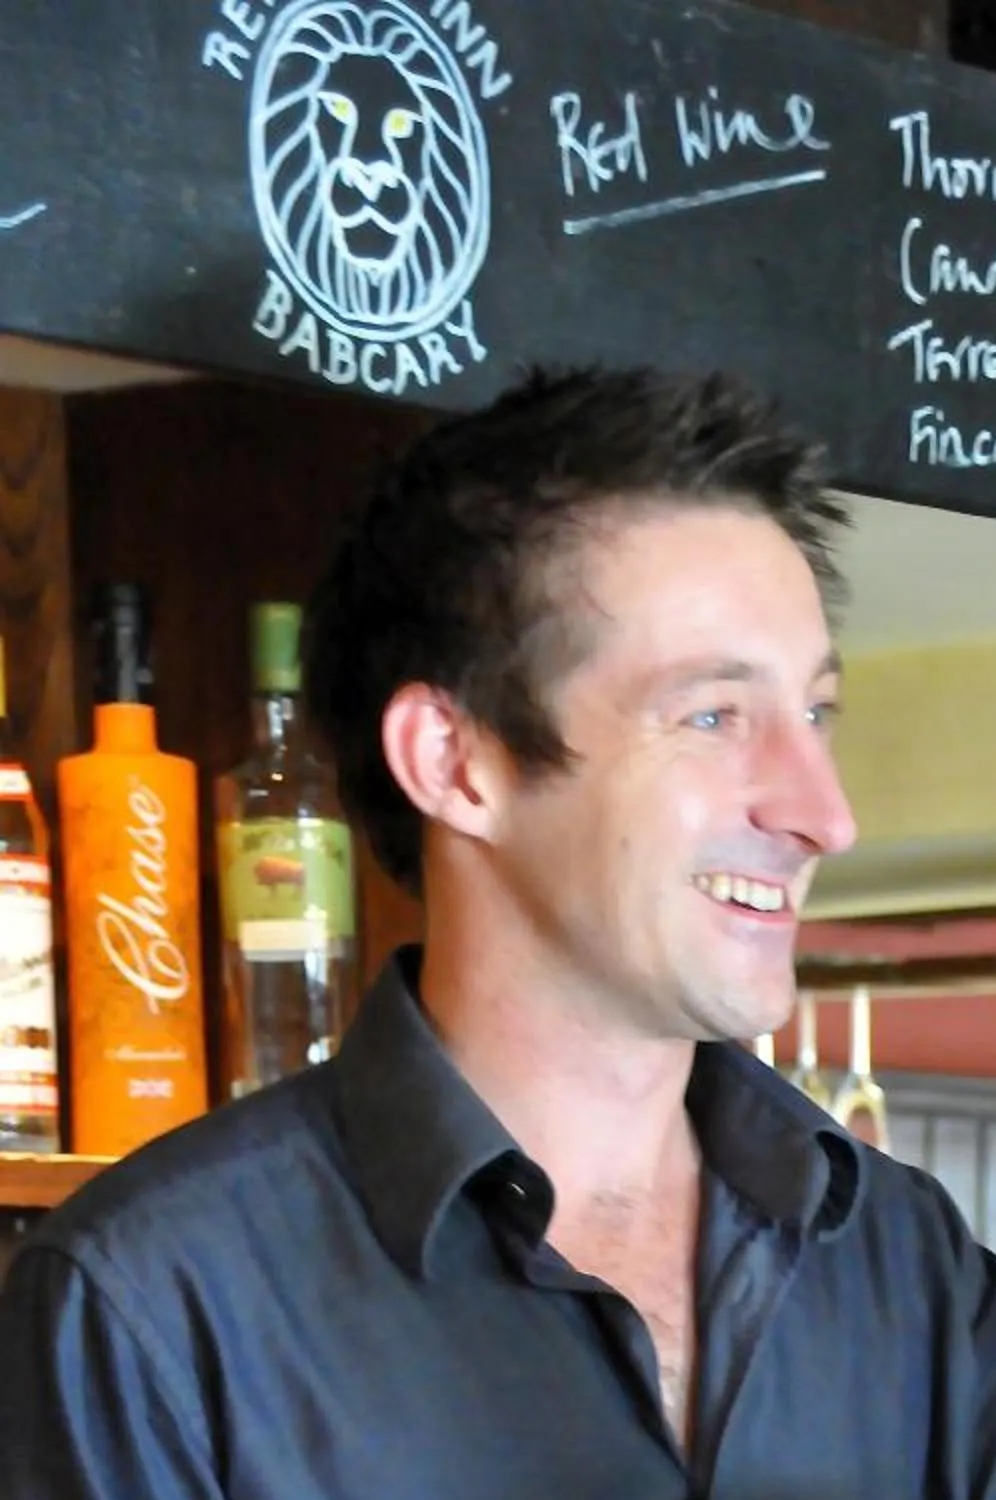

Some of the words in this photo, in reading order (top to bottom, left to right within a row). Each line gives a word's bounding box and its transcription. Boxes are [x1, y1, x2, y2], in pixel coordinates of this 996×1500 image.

[202, 0, 276, 80] RE
[550, 91, 647, 197] Red
[675, 85, 832, 168] Wine
[252, 268, 488, 396] BABCARY
[95, 782, 191, 1016] Chase
